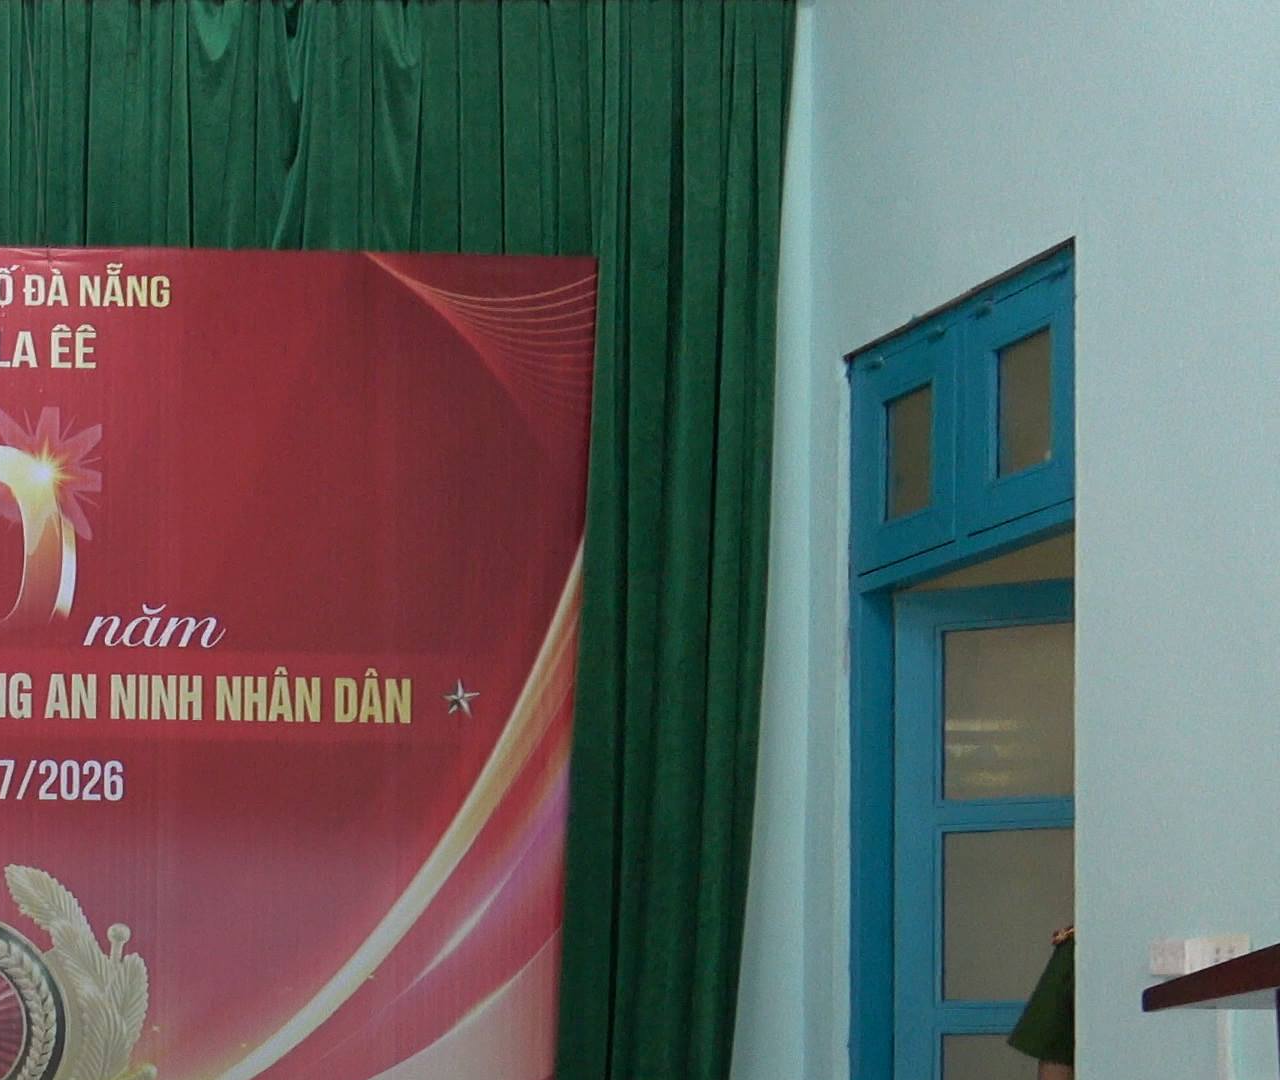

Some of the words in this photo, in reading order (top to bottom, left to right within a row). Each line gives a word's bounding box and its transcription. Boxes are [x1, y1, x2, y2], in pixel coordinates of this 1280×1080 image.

[22, 268, 69, 307] ĐÀ
[79, 262, 171, 308] NẴNG
[50, 323, 97, 369] ÊÊ
[82, 603, 226, 649] năm
[44, 673, 97, 719] AN
[110, 674, 203, 721] NINH
[215, 666, 321, 723] NHÂN
[334, 667, 412, 724] DÂN
